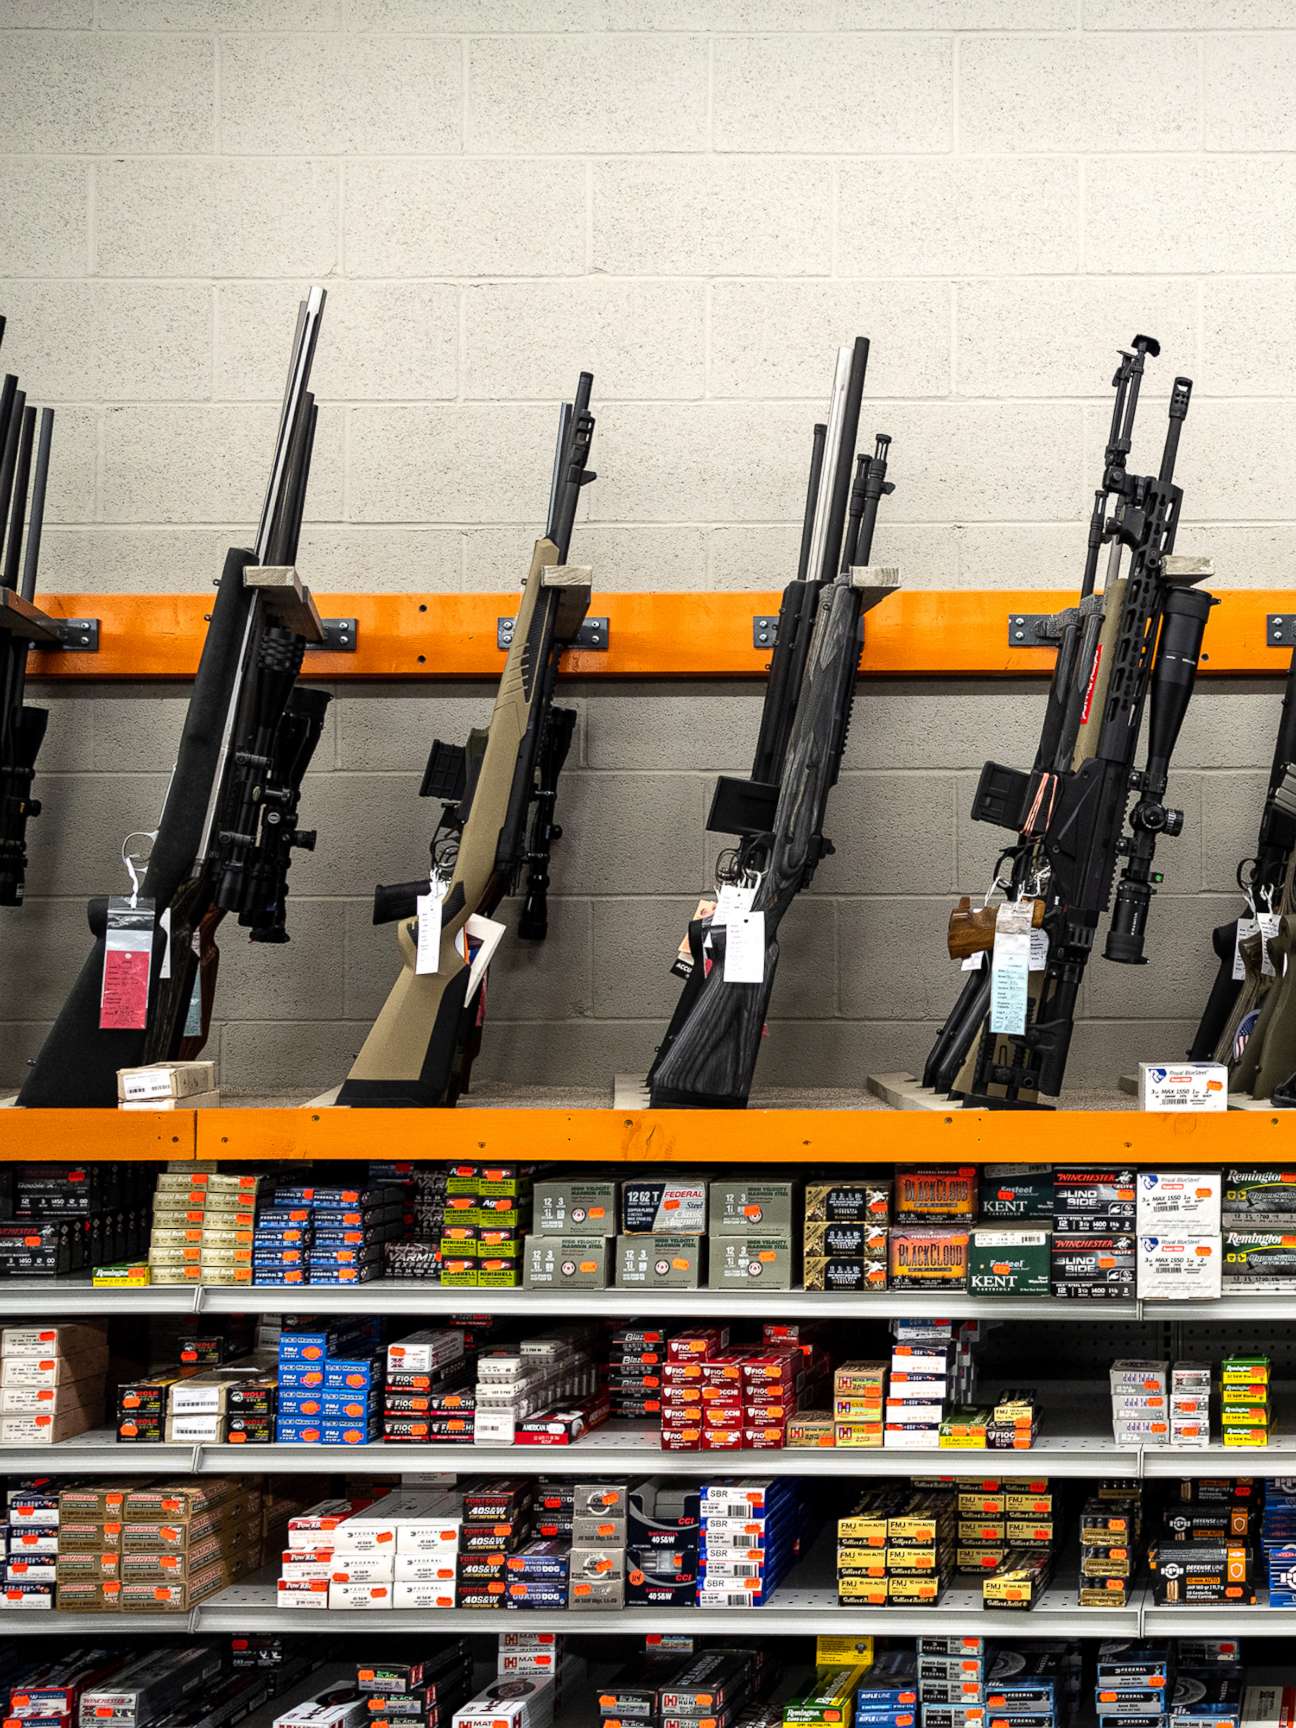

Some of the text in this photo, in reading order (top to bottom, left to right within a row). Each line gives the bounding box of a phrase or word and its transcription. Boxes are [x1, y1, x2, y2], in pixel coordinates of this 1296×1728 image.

[627, 1192, 659, 1201] 12 62 T
[558, 1197, 563, 1205] 3
[984, 1201, 1027, 1211] KENT
[1056, 1240, 1113, 1248] WINCHESTER
[533, 1250, 552, 1259] 12 3
[625, 1250, 646, 1258] 12 3
[971, 1276, 1017, 1287] KENT
[522, 1423, 547, 1432] AMERICAN
[710, 1490, 728, 1498] SBR
[678, 1517, 695, 1525] CCI
[710, 1520, 728, 1528] SBR
[710, 1549, 728, 1557] SBR
[891, 1579, 908, 1587] FMJ
